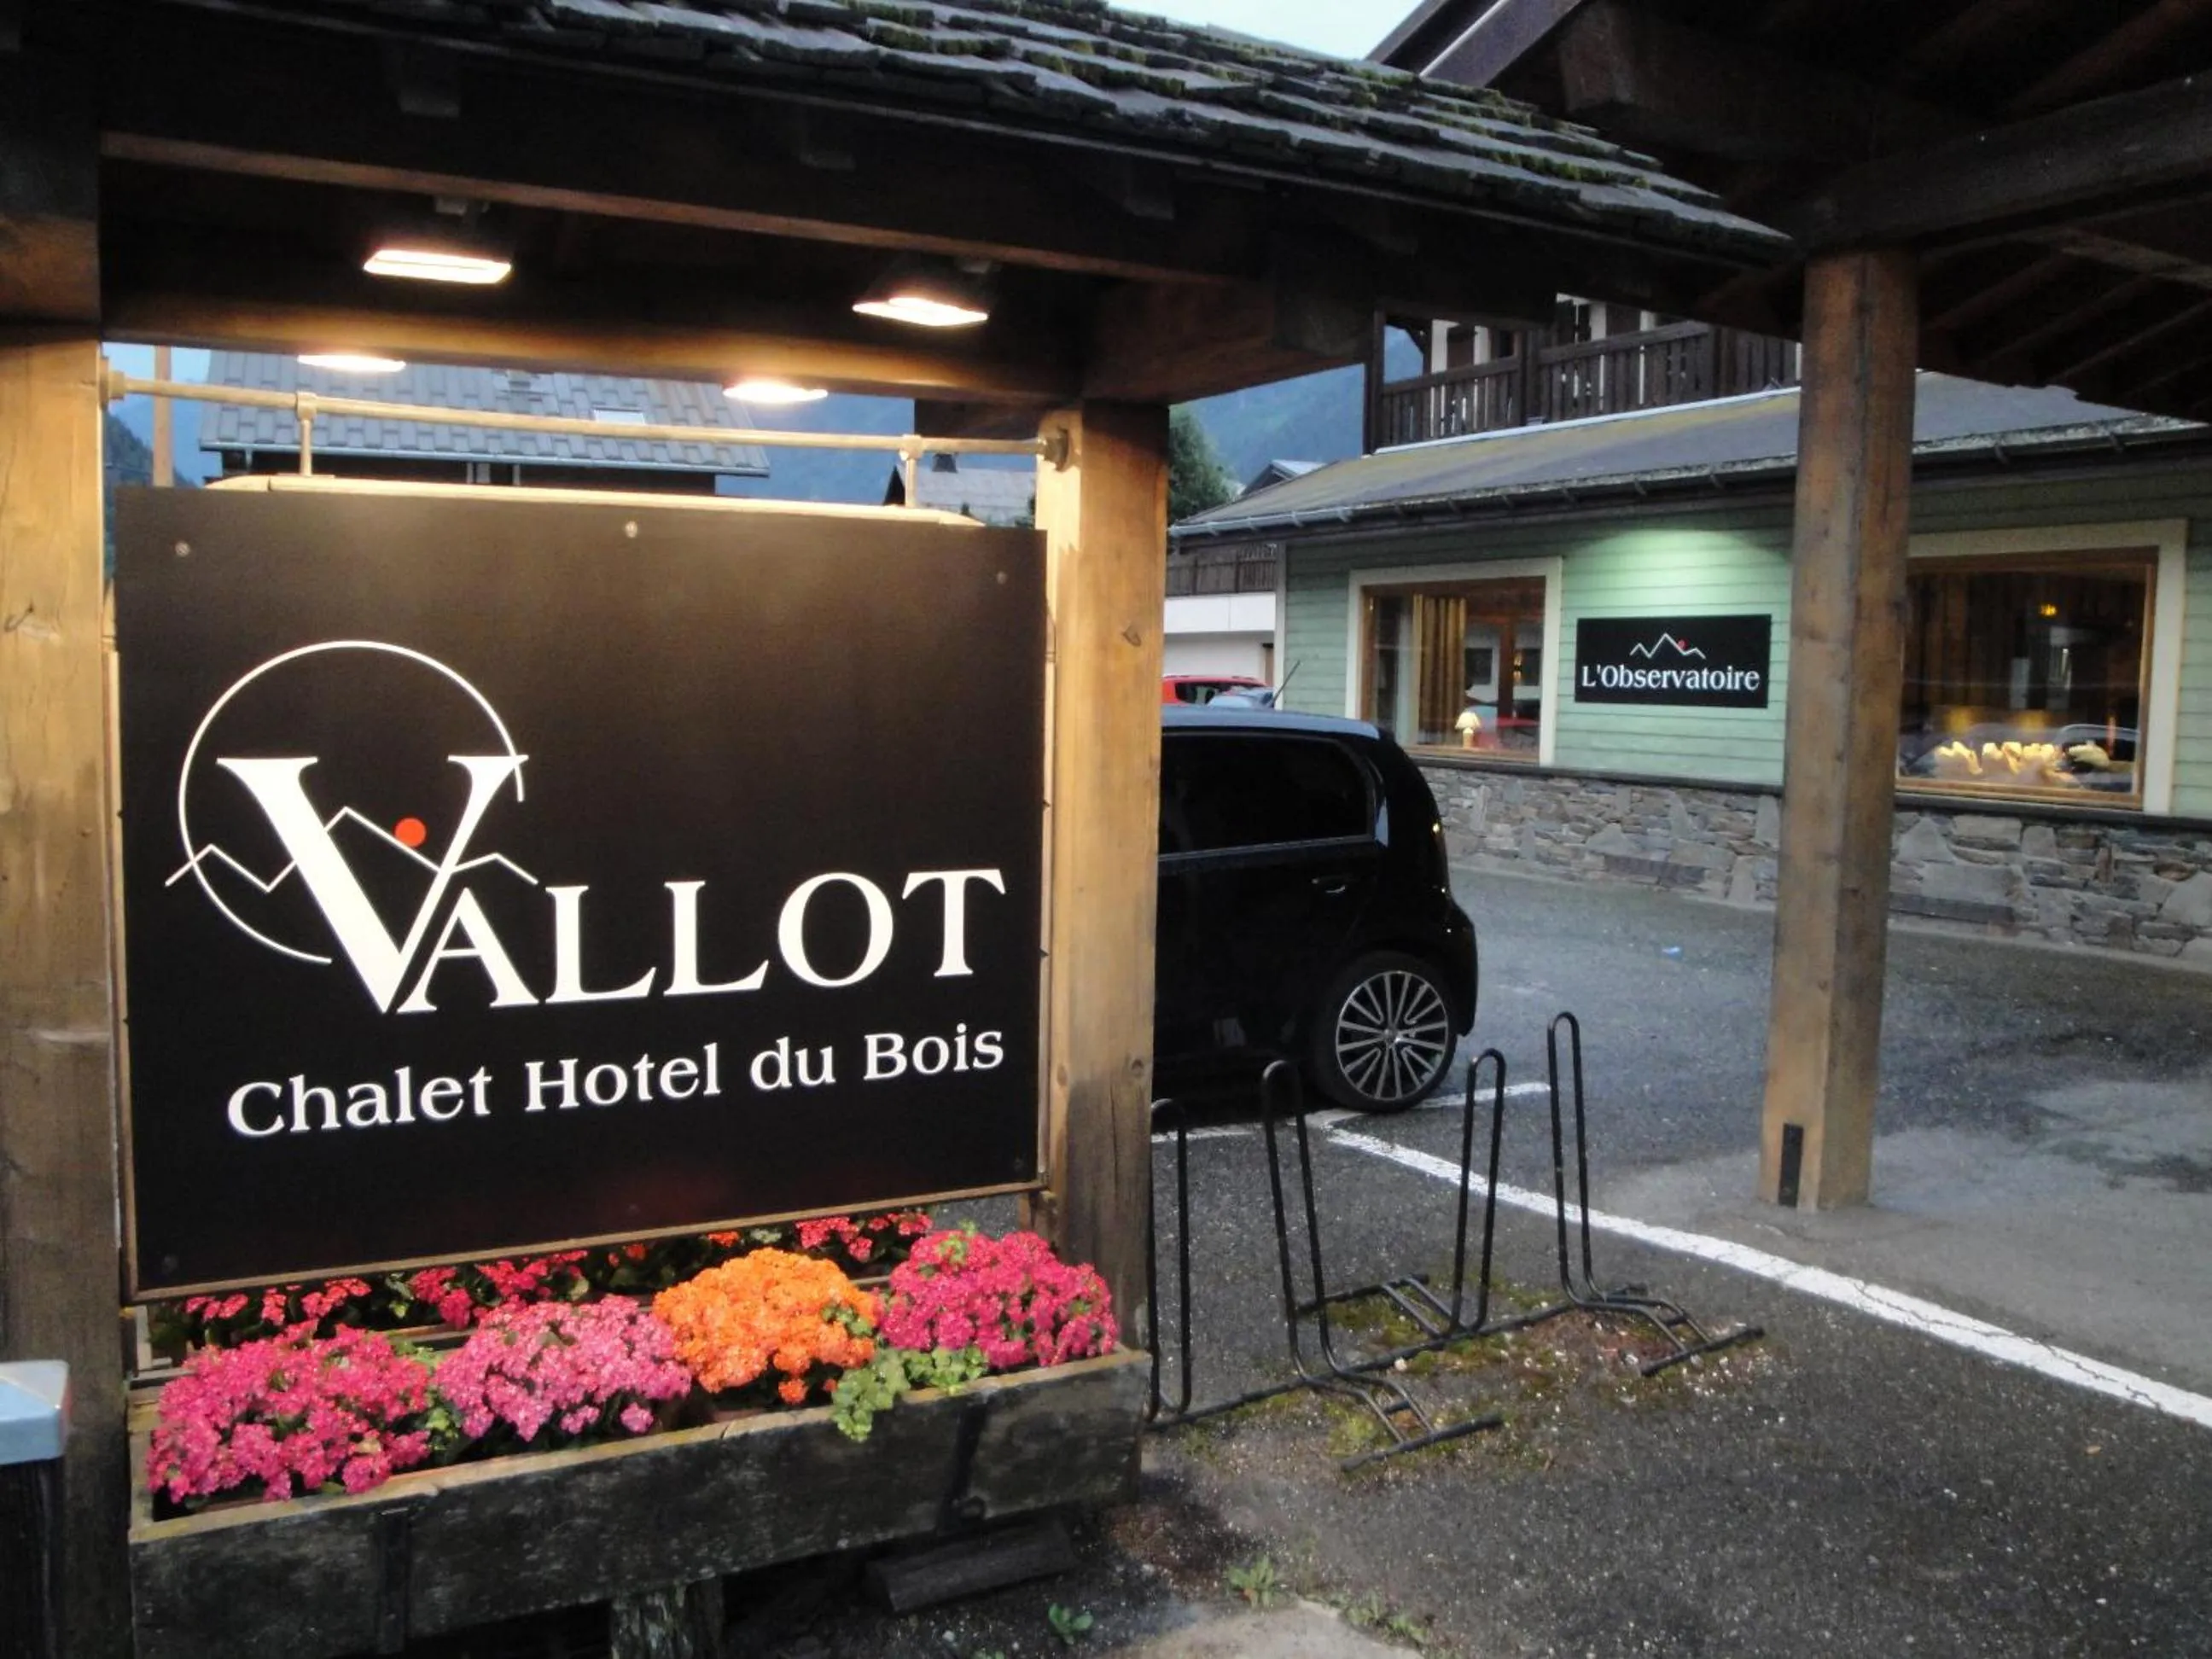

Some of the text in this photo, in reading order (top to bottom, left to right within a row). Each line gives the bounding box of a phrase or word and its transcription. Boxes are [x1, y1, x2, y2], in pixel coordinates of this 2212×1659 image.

[1581, 664, 1761, 691] L'Observatoire
[217, 754, 1007, 1015] VALLOT
[227, 1022, 1005, 1138] Chalet Hotel du Bois
